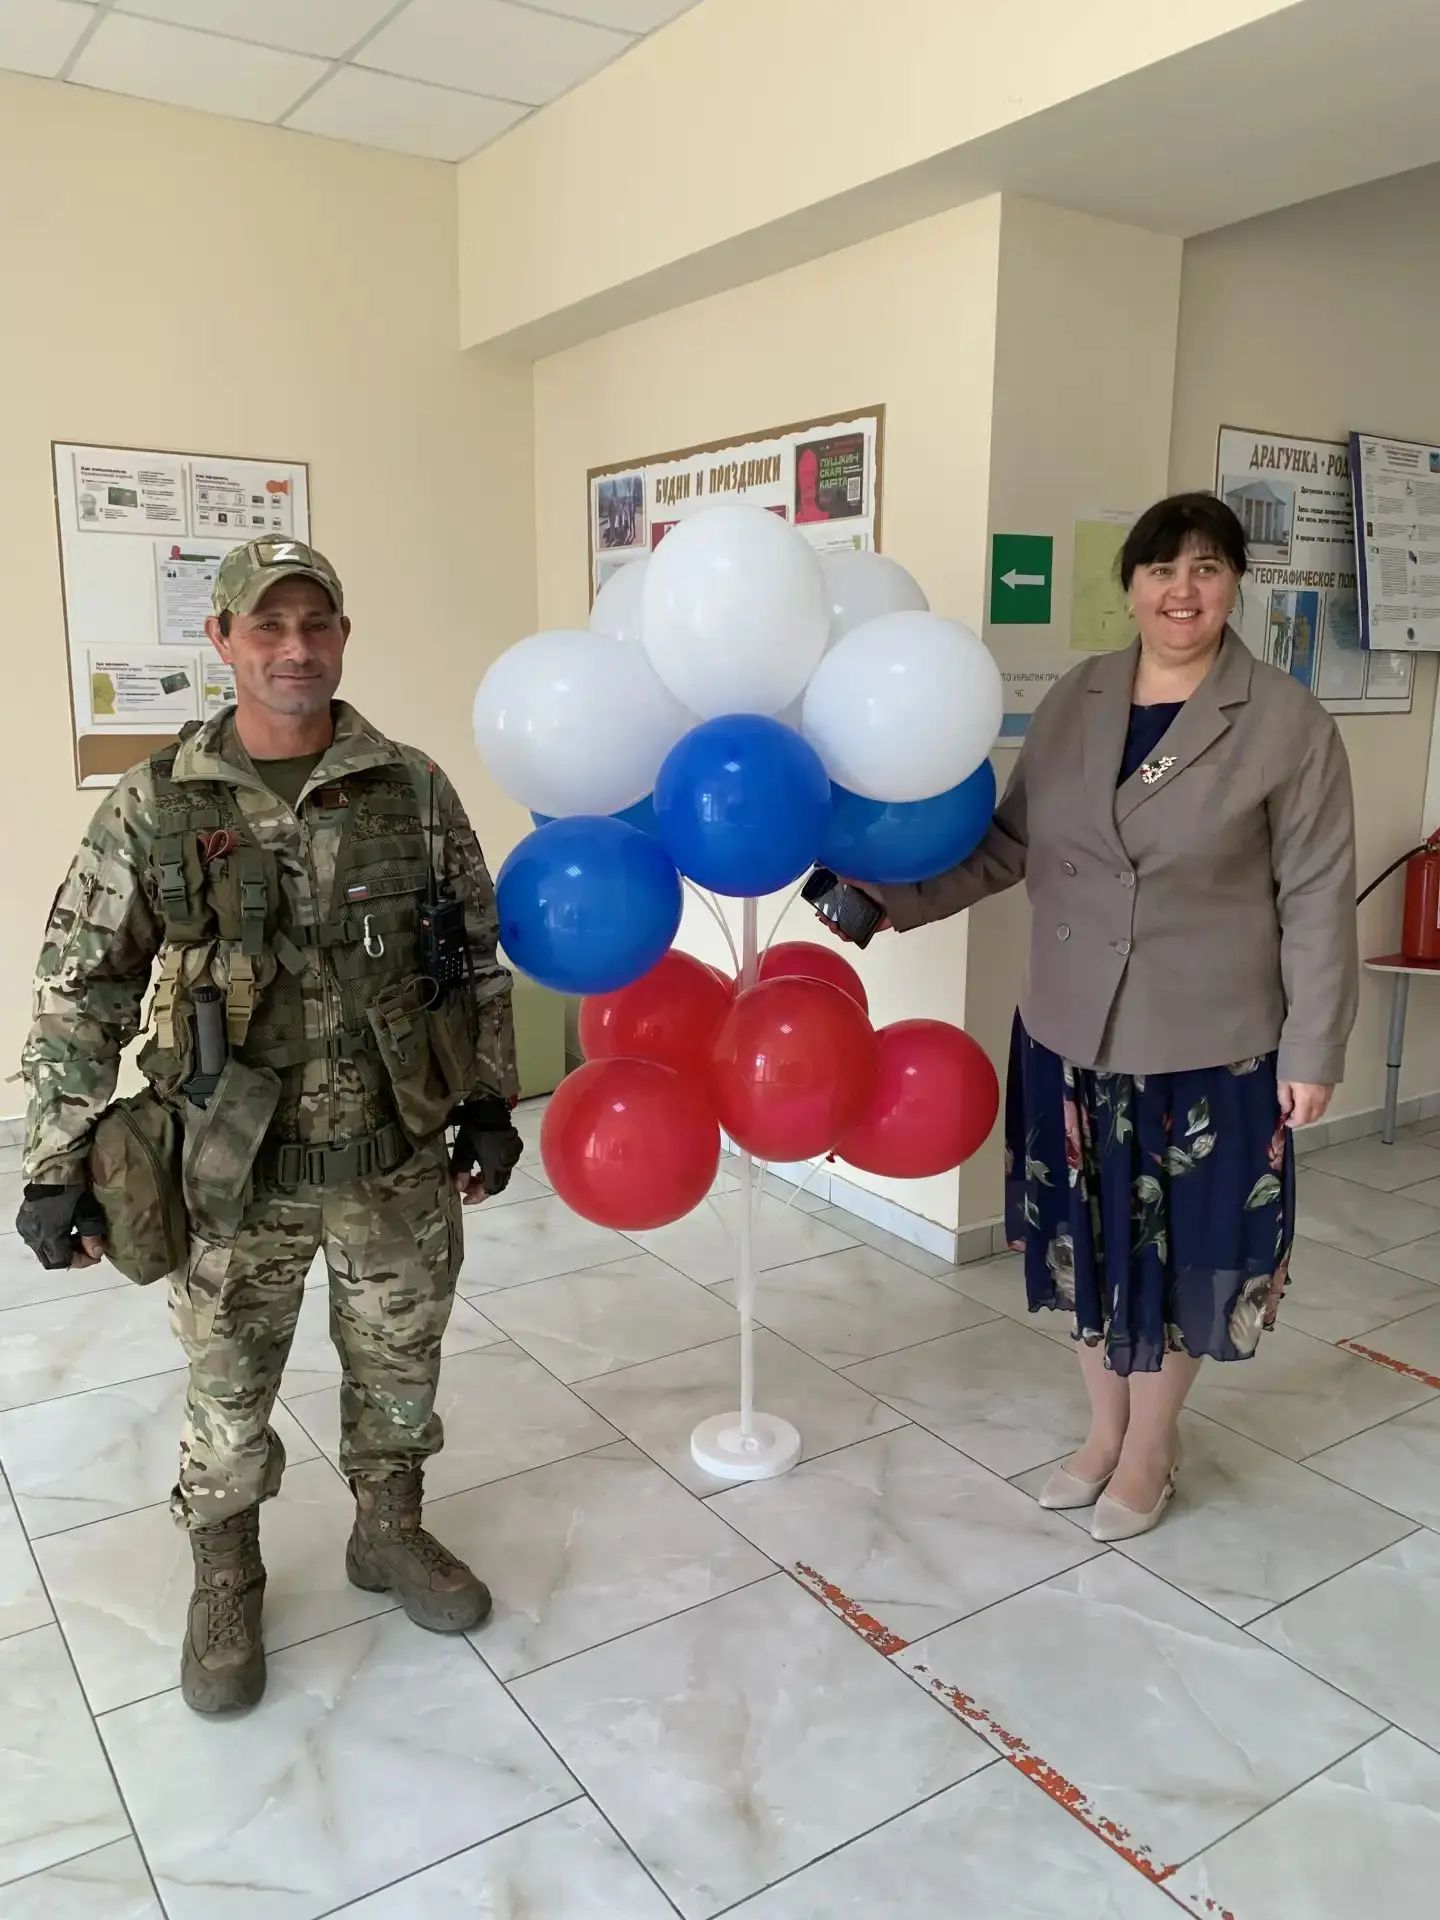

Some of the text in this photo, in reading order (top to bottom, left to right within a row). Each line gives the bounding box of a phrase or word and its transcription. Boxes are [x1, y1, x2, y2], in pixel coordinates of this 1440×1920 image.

[820, 452, 859, 467] ПУШКИН
[1249, 443, 1319, 474] ДРАГУНКА
[1327, 453, 1350, 481] РОД
[655, 453, 782, 506] БУДНИ И ПРАЗДНИКИ
[820, 467, 841, 478] СКАЯ
[271, 543, 300, 561] Z
[1254, 567, 1358, 590] ГЕОГРАФИЧЕСКОЕ ПОЛ
[1013, 673, 1044, 682] УКРЫТИЯ
